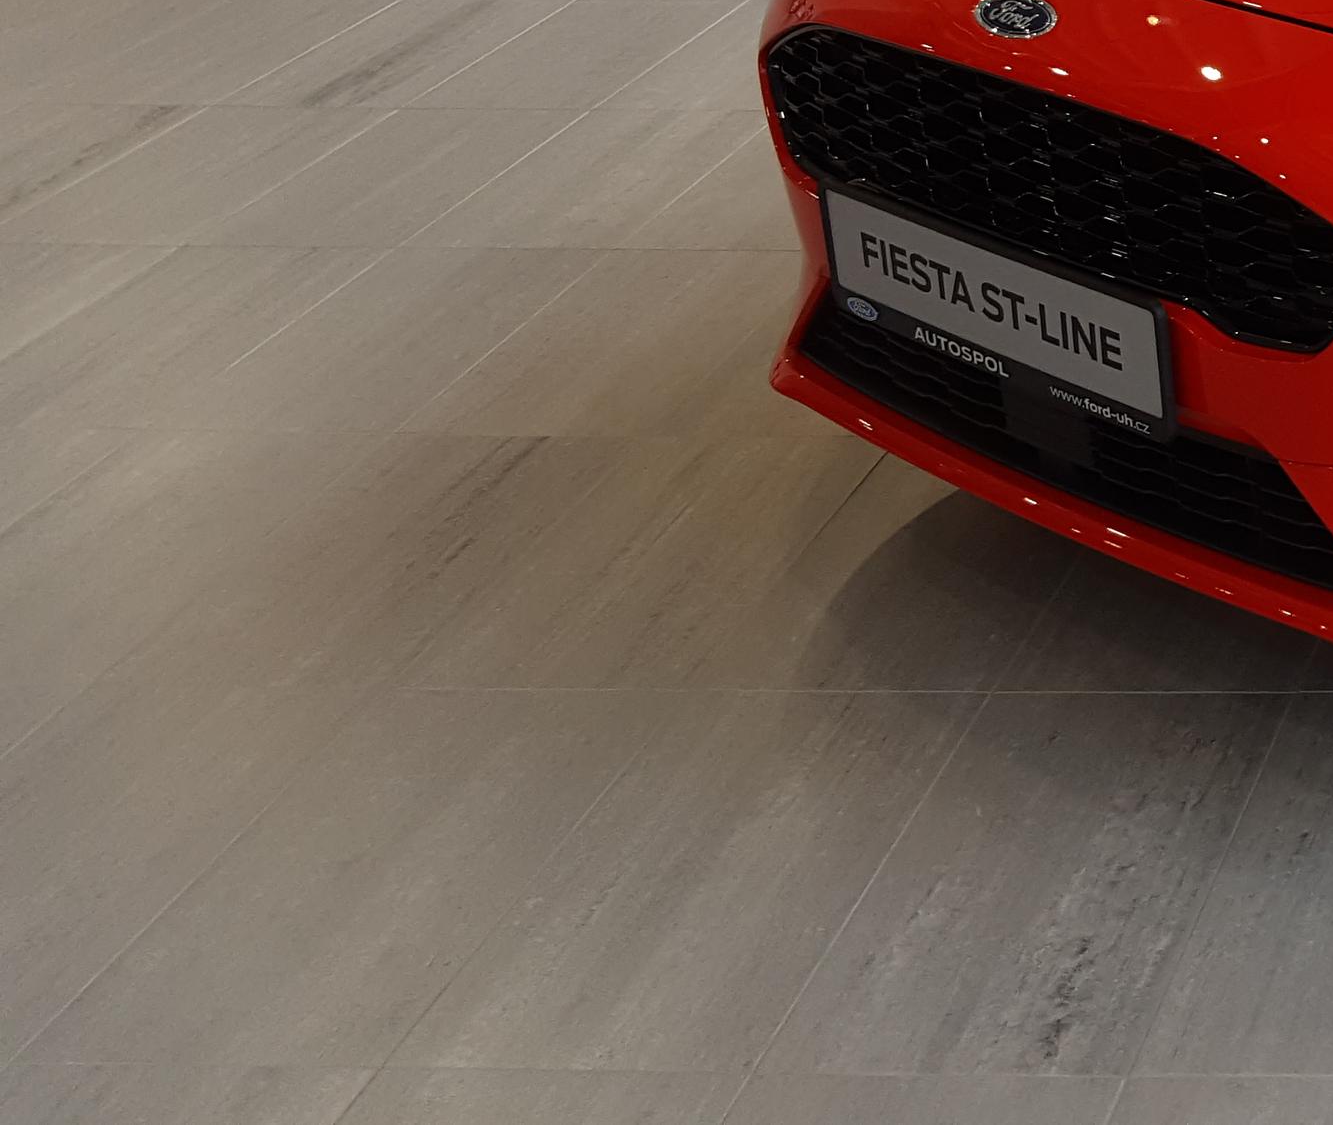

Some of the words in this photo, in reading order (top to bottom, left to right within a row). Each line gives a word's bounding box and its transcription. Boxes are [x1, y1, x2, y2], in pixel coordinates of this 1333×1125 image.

[987, 0, 1041, 29] Ford
[860, 231, 976, 313] FIESTA
[914, 326, 1010, 378] AUTOSPOL
[981, 281, 1123, 372] ST-LINE
[1049, 386, 1151, 435] www.ford-uh.cz
